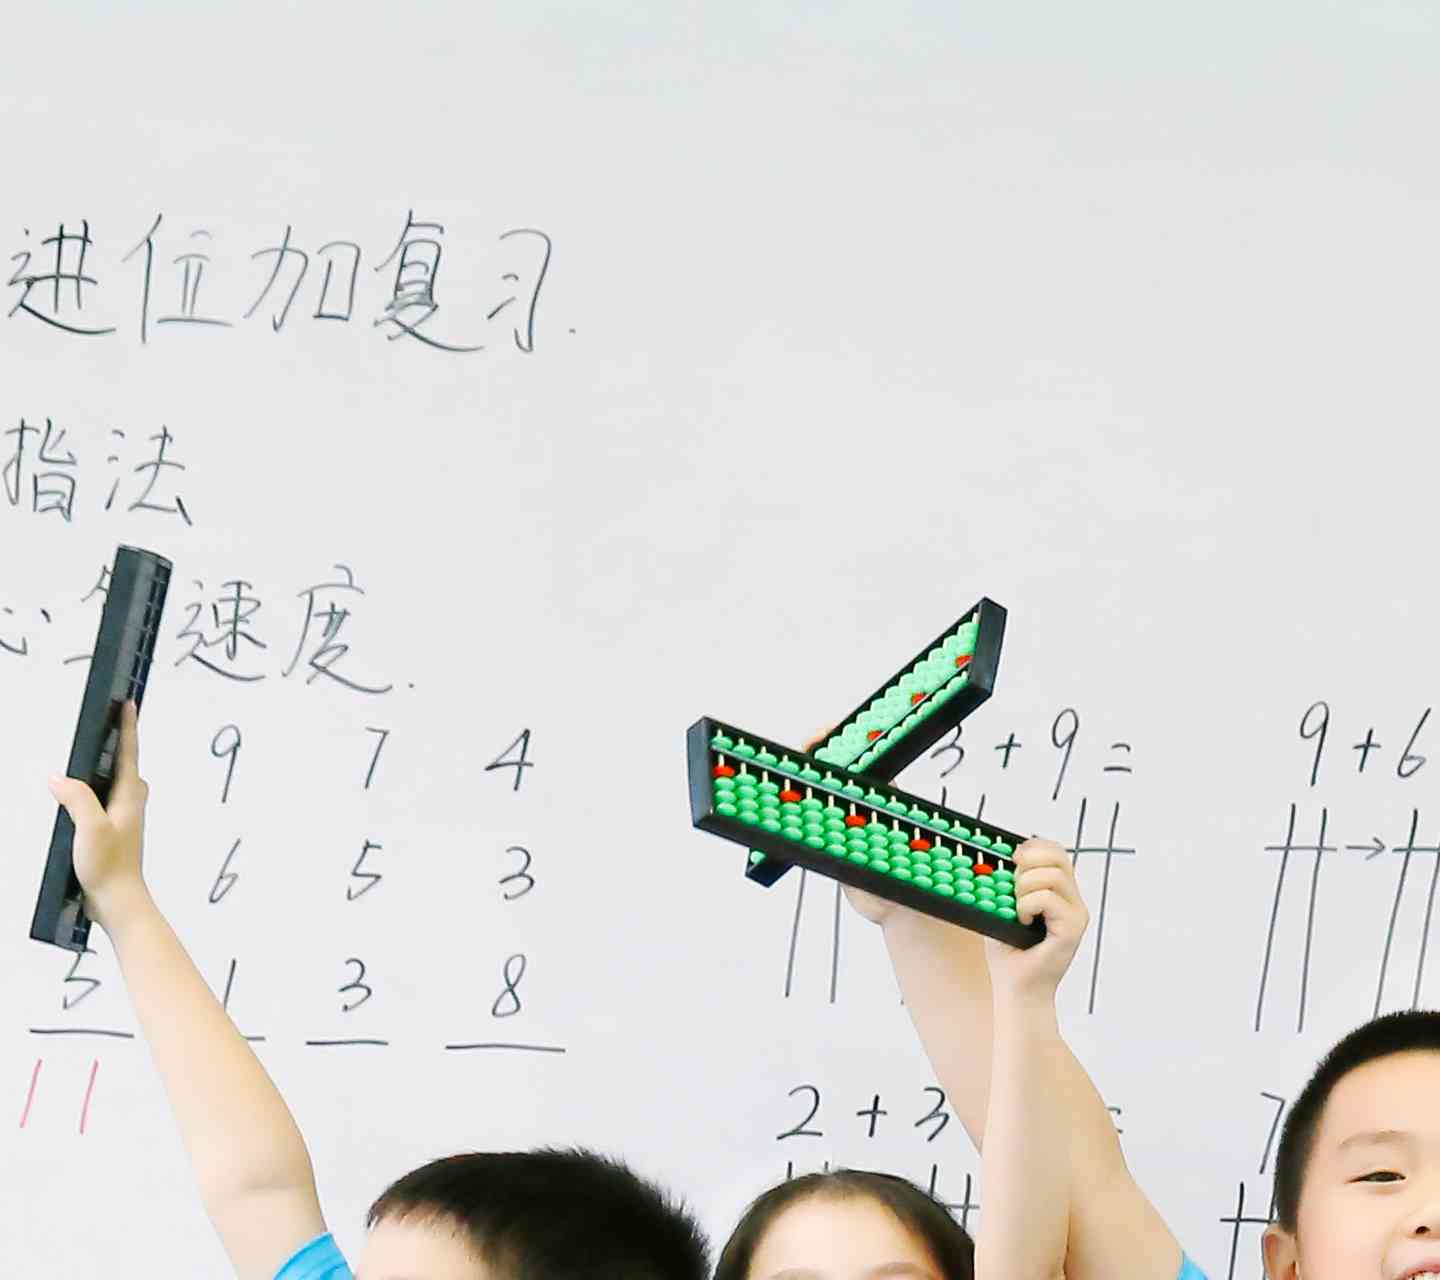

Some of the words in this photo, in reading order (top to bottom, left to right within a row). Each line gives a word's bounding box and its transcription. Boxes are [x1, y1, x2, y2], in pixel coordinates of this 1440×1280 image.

[211, 724, 241, 804] 9
[364, 727, 389, 788] 7
[484, 728, 534, 792] 4
[208, 838, 241, 904] 6
[346, 839, 383, 901] 5
[498, 846, 535, 900] 3
[63, 950, 101, 1010] 5
[337, 958, 372, 1013] 3
[492, 954, 526, 1018] 8
